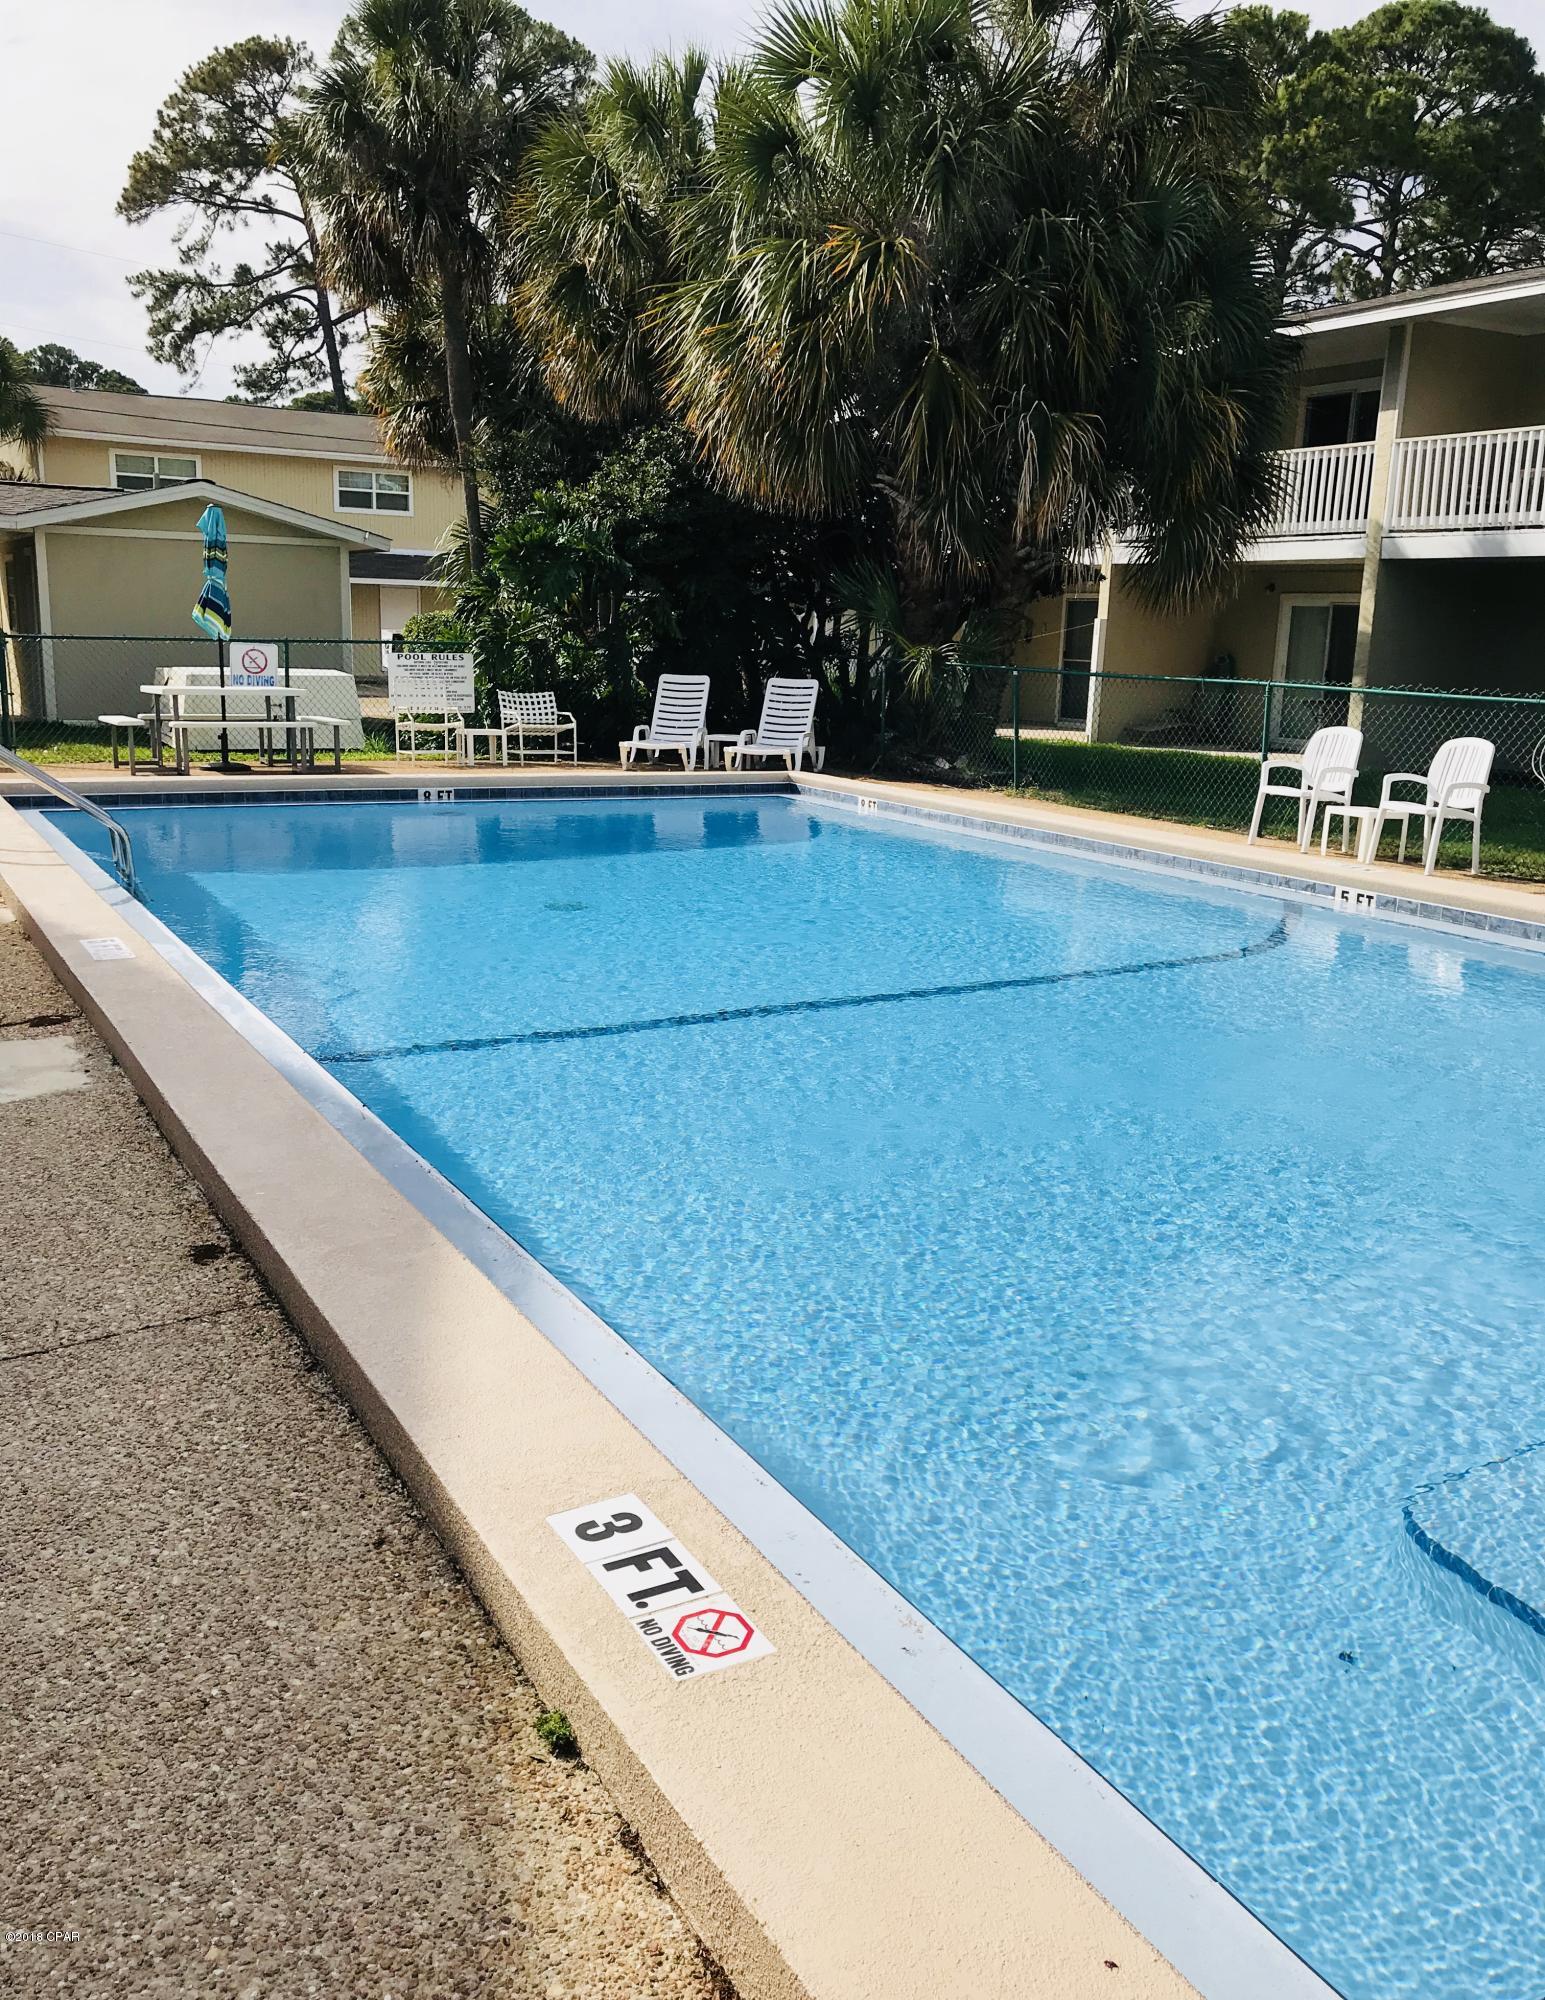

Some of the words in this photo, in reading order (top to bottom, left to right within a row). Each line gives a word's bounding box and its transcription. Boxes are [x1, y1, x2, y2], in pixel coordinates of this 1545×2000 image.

[431, 653, 465, 661] RULES
[232, 674, 244, 686] NO
[247, 675, 275, 687] DIVING
[438, 791, 452, 800] FT
[1341, 890, 1349, 902] 5
[1356, 893, 1374, 906] FT
[575, 1512, 643, 1541] 3
[602, 1546, 705, 1609] FT.
[636, 1618, 663, 1637] NO
[651, 1636, 695, 1677] DIVING
